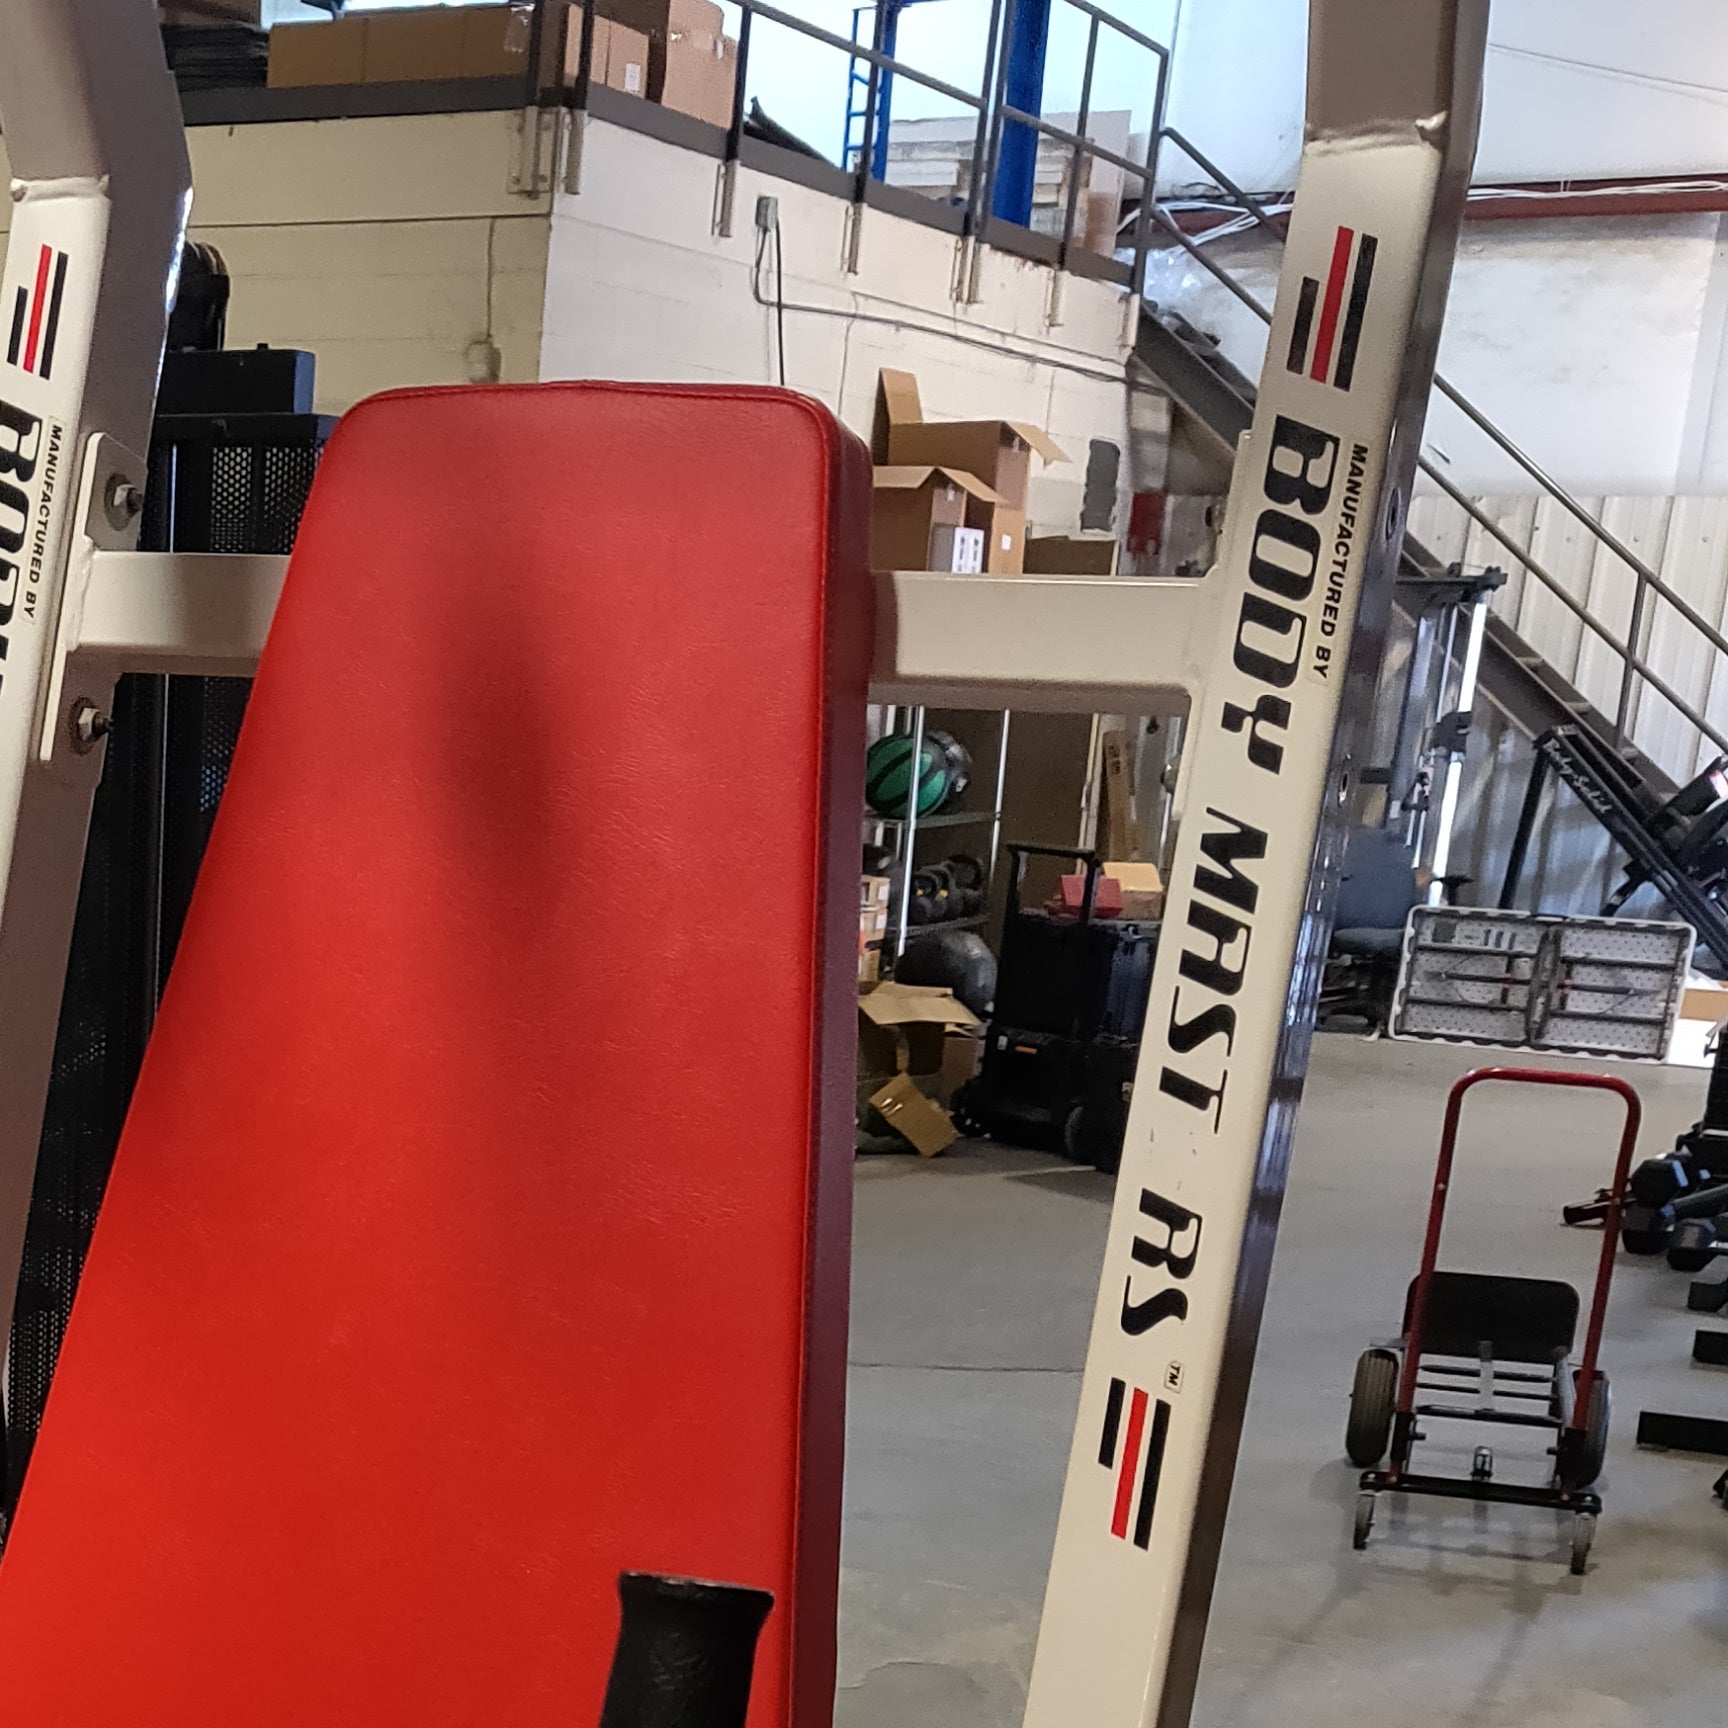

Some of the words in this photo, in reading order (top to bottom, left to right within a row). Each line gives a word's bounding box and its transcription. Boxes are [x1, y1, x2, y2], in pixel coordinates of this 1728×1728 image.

[29, 425, 62, 584] MANUFACTURED
[1321, 444, 1368, 637] MANUFACTURED
[23, 591, 36, 619] BY
[1221, 415, 1340, 774] BODY
[1313, 645, 1331, 679] BY
[1120, 806, 1268, 1336] MASTRS
[1168, 1364, 1180, 1386] TM
